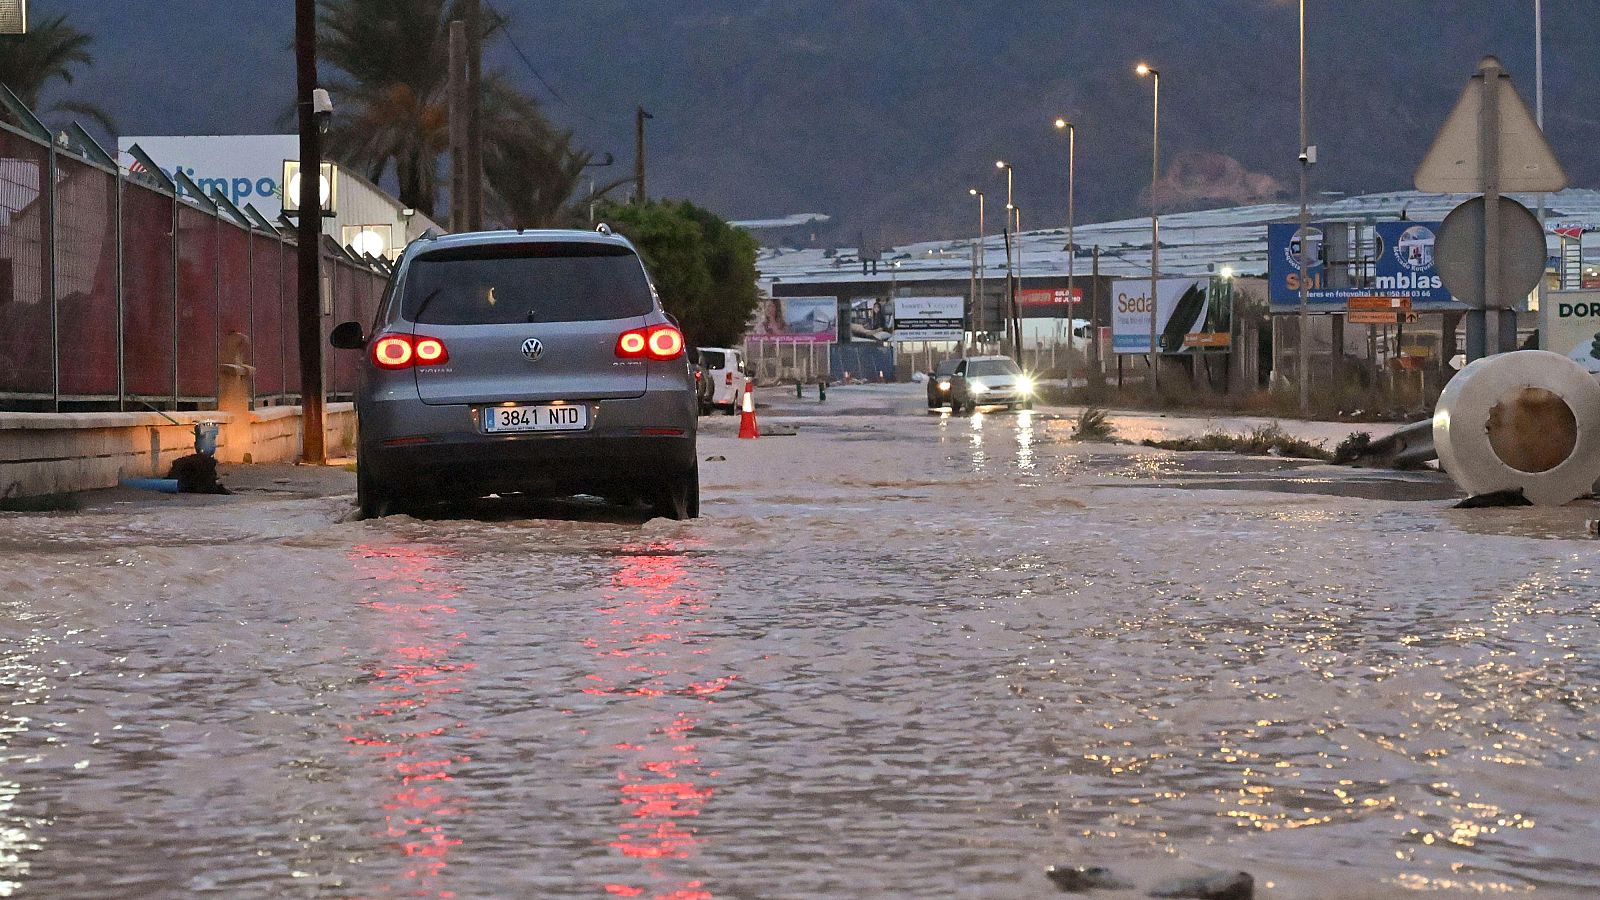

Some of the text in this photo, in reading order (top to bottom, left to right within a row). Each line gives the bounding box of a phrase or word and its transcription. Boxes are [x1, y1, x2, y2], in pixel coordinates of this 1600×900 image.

[160, 166, 277, 206] lmpo
[501, 407, 579, 426] 3841 NTD
